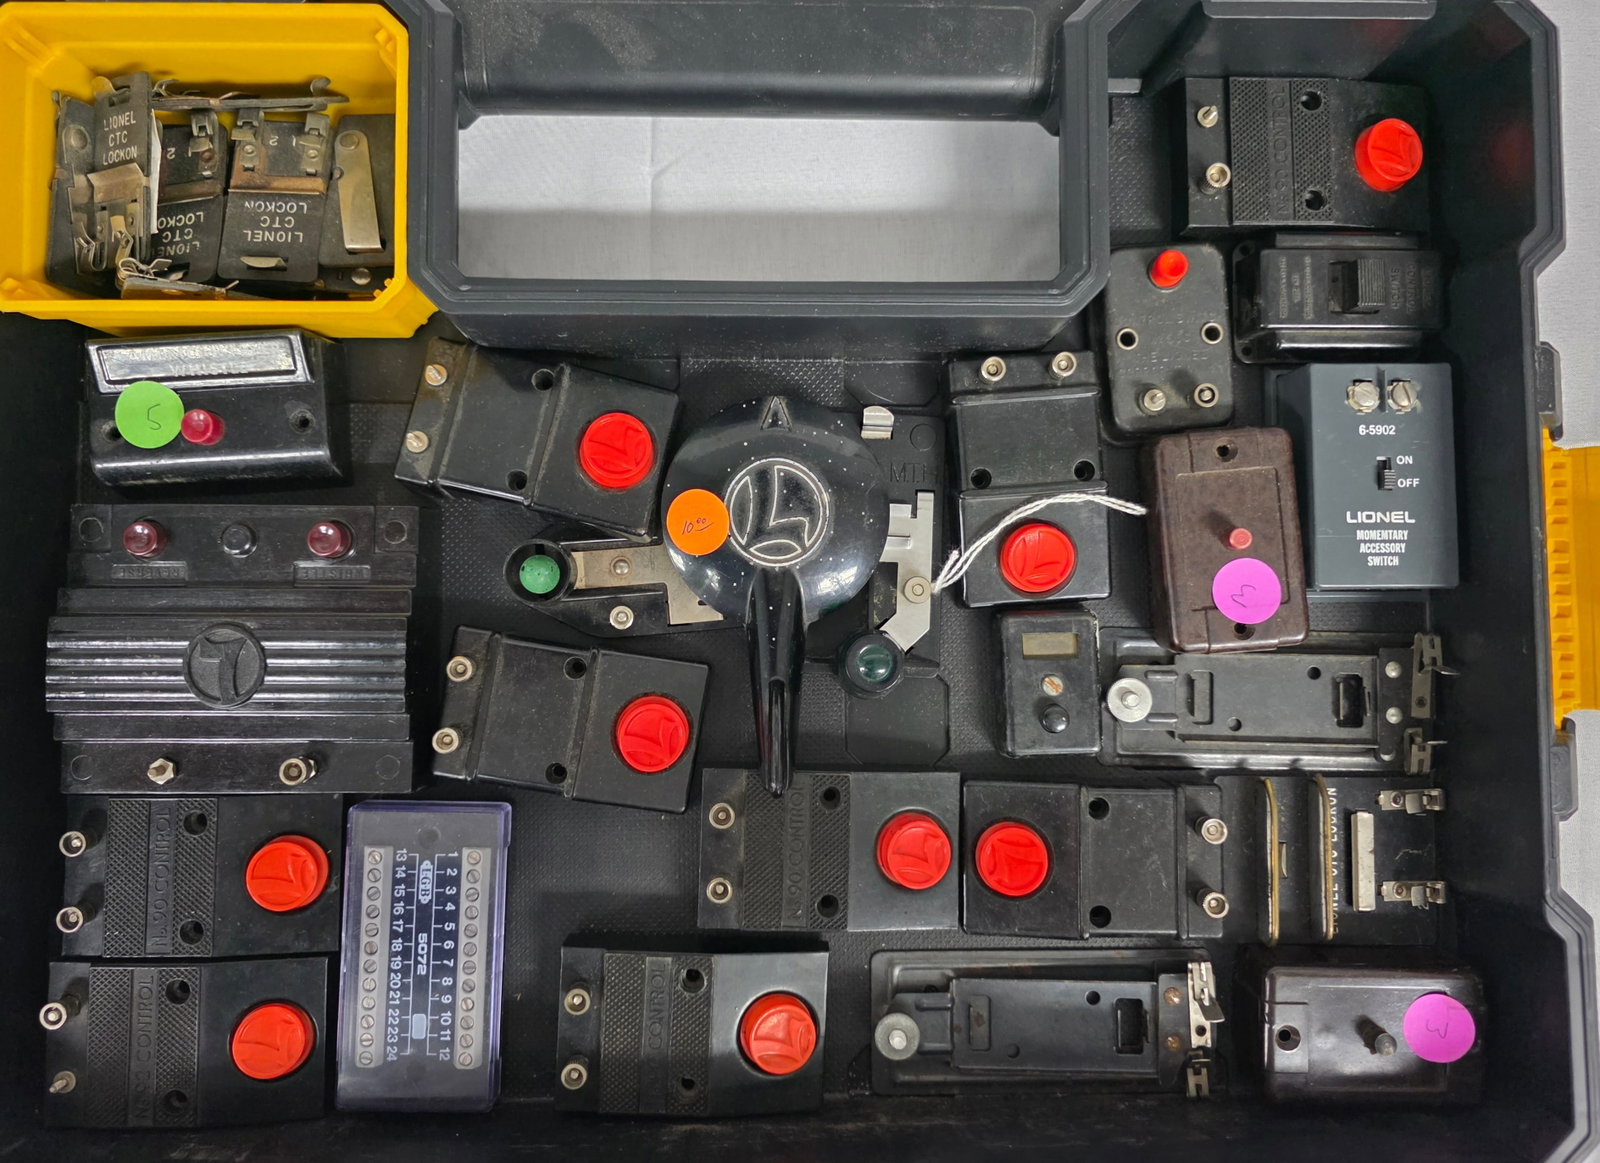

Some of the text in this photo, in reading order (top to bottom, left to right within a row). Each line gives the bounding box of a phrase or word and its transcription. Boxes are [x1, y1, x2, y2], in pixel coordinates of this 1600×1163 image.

[103, 111, 136, 131] LIONEL
[1271, 86, 1288, 164] CONTROL
[108, 131, 128, 147] CTC
[269, 135, 279, 146] 2
[103, 146, 137, 165] LOCKON
[244, 201, 308, 214] LOCKON
[158, 212, 204, 229] LOCKO
[259, 216, 295, 228] CTC
[162, 229, 193, 243] CTC
[243, 230, 304, 243] LIONEL
[1358, 424, 1396, 436] 6-5902
[1396, 455, 1413, 465] ON
[1397, 478, 1420, 488] OFF
[1346, 511, 1416, 524] LIONEL
[1359, 543, 1406, 553] ACCESSORY
[1367, 556, 1399, 566] SWITCH
[154, 807, 171, 894] CONTROL
[396, 848, 407, 861] 13
[395, 865, 406, 879] 14
[446, 868, 458, 876] 2
[394, 883, 405, 897] 15
[445, 886, 457, 895] 3
[788, 872, 802, 895] 90
[393, 901, 404, 915] 16
[445, 902, 456, 911] 4
[392, 919, 404, 933] 17
[444, 922, 455, 931] 5
[391, 937, 402, 952] 18
[443, 940, 455, 950] 6
[417, 933, 428, 975] 5072
[390, 955, 402, 970] 19
[443, 958, 454, 967] 7
[389, 973, 401, 988] 20
[441, 976, 453, 986] 8
[389, 991, 400, 1005] 21
[441, 994, 452, 1004] 9
[648, 964, 666, 1050] CONTROL
[136, 975, 154, 1063] CONTROL
[388, 1009, 399, 1025] 22
[440, 1011, 452, 1026] 10
[387, 1026, 398, 1043] 23
[440, 1029, 451, 1041] 11
[386, 1046, 397, 1061] 24
[440, 1047, 451, 1061] 12
